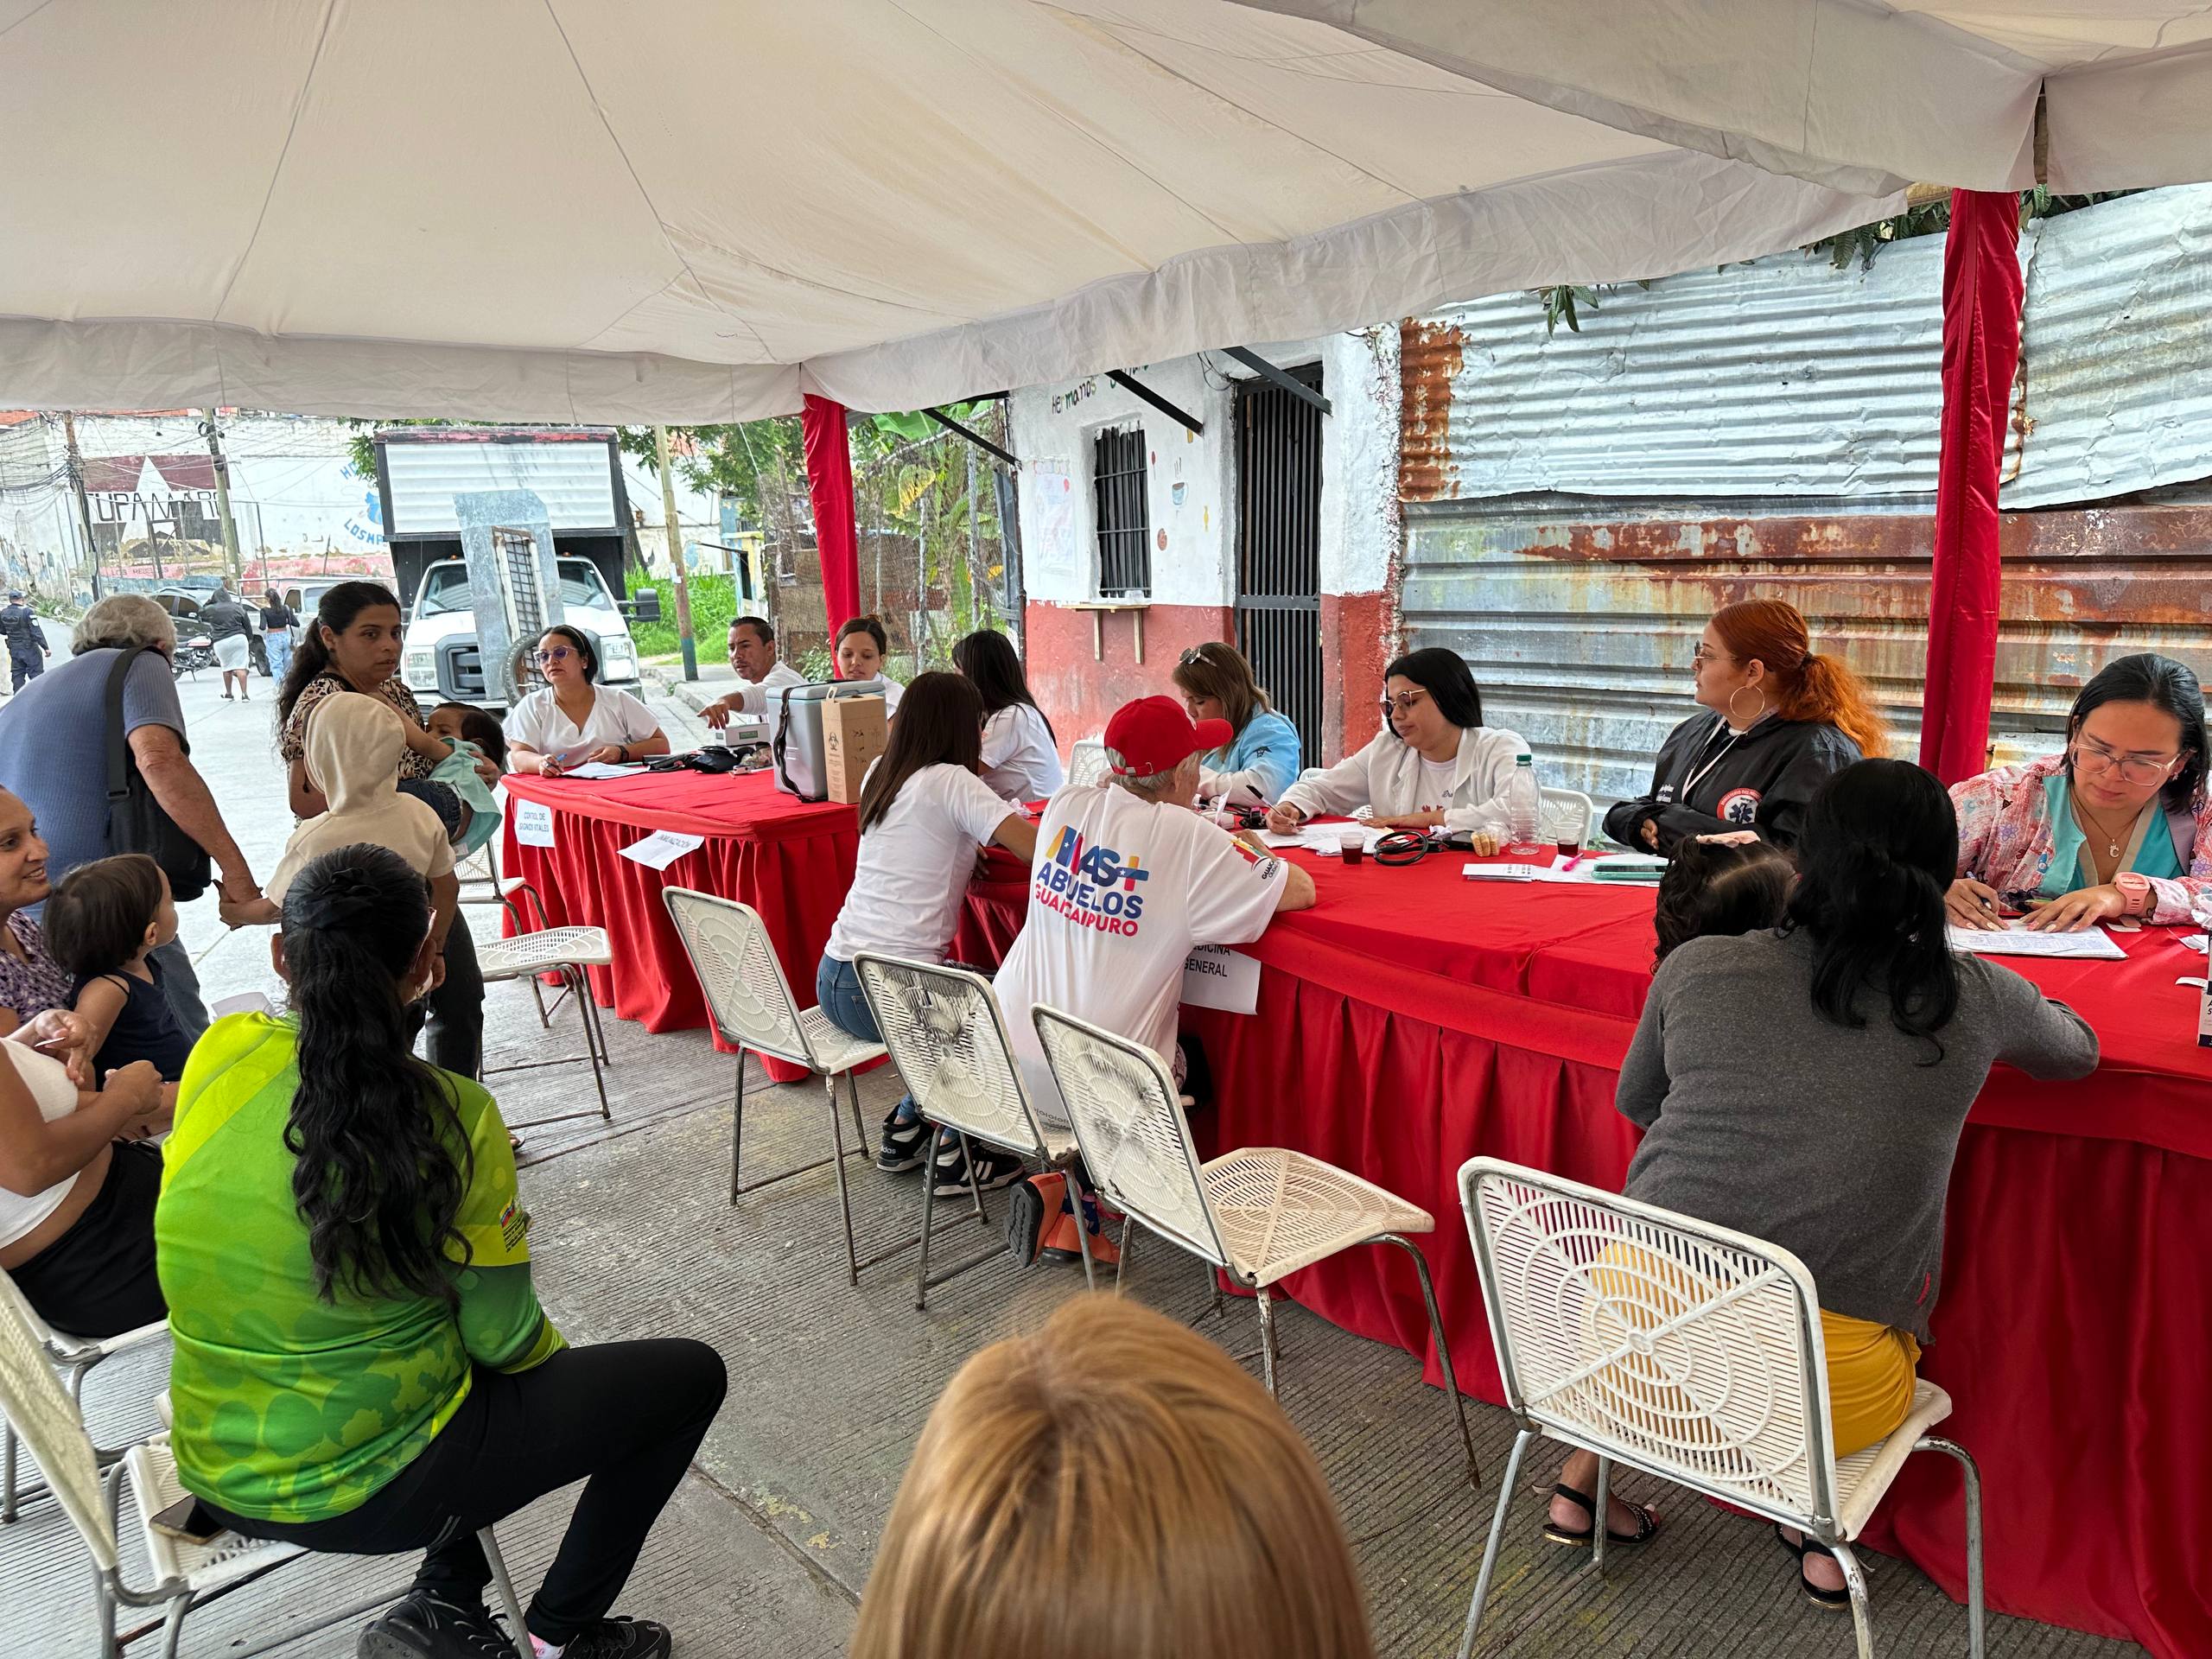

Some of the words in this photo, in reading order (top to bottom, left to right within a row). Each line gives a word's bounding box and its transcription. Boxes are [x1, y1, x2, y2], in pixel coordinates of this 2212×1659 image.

[1052, 379, 1096, 415] Hermanos
[86, 490, 221, 522] UPAMAR
[1037, 861, 1143, 919] ABUELOS
[1035, 883, 1139, 937] GUAICAIPURO
[1185, 957, 1228, 977] GENERAL
[1193, 944, 1230, 957] DICINA
